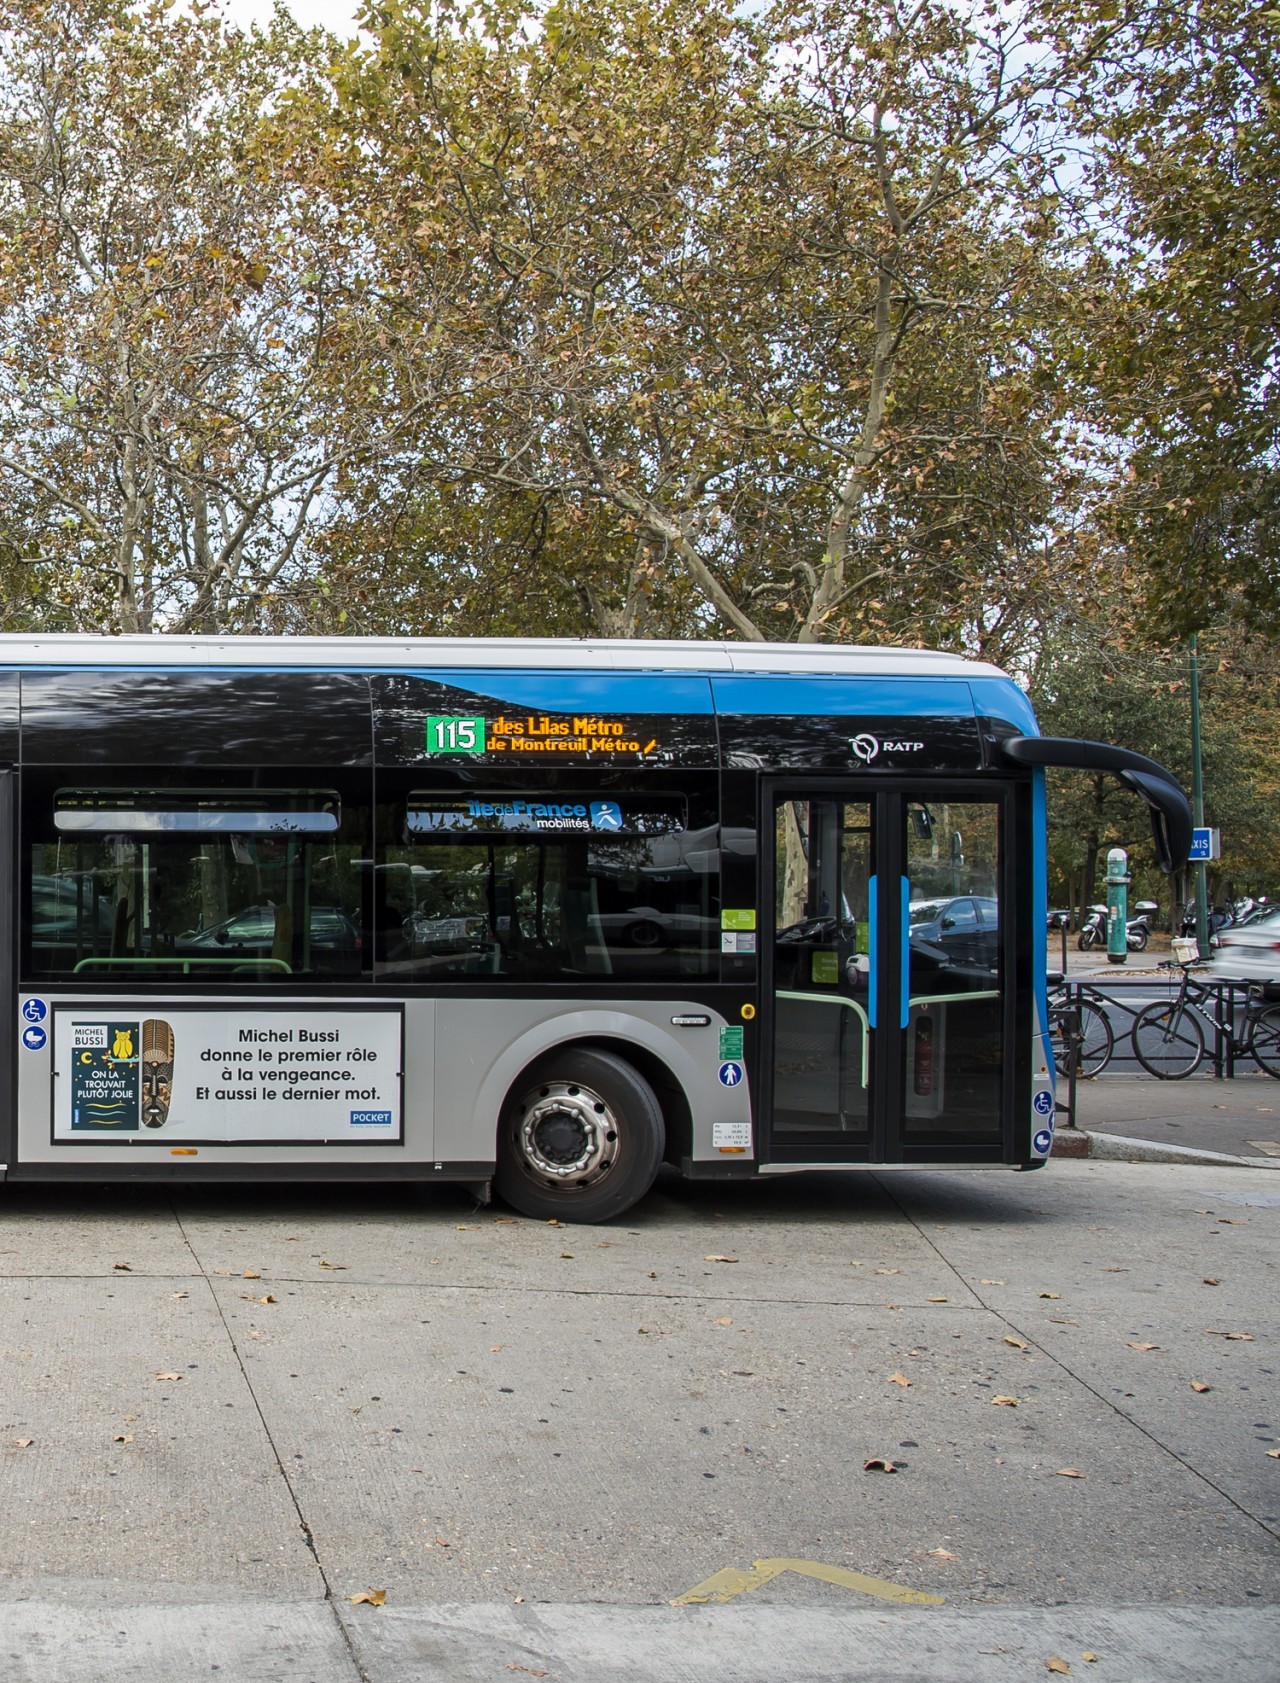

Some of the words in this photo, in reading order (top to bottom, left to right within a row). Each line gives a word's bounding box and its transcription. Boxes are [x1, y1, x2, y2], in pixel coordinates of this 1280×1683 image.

[492, 716, 525, 735] des
[526, 716, 571, 736] Lilas
[571, 716, 625, 736] Métro
[435, 721, 475, 748] 115
[486, 736, 508, 751] de
[510, 737, 589, 751] Montreuil
[591, 737, 640, 752] Métro
[882, 741, 924, 752] RATP
[535, 817, 591, 829] mobilités
[74, 1028, 104, 1036] MICHEL
[238, 1029, 293, 1043] Michel
[298, 1029, 340, 1043] Bussi
[74, 1036, 104, 1046] BUSSI
[200, 1048, 253, 1062] donne
[258, 1048, 273, 1062] le
[278, 1048, 342, 1065] premier
[346, 1047, 378, 1062] rôle
[91, 1070, 107, 1079] ON
[108, 1070, 120, 1079] LA
[221, 1066, 233, 1081] à
[237, 1067, 253, 1081] la
[258, 1070, 356, 1085] vengeance.
[84, 1080, 126, 1089] TROUVAIT
[77, 1088, 109, 1099] PLUTÔT
[110, 1089, 133, 1099] JOLIE
[196, 1086, 210, 1100] Et
[214, 1087, 257, 1101] aussi
[262, 1087, 277, 1101] le
[281, 1087, 341, 1101] dernier
[345, 1086, 381, 1100] mot.
